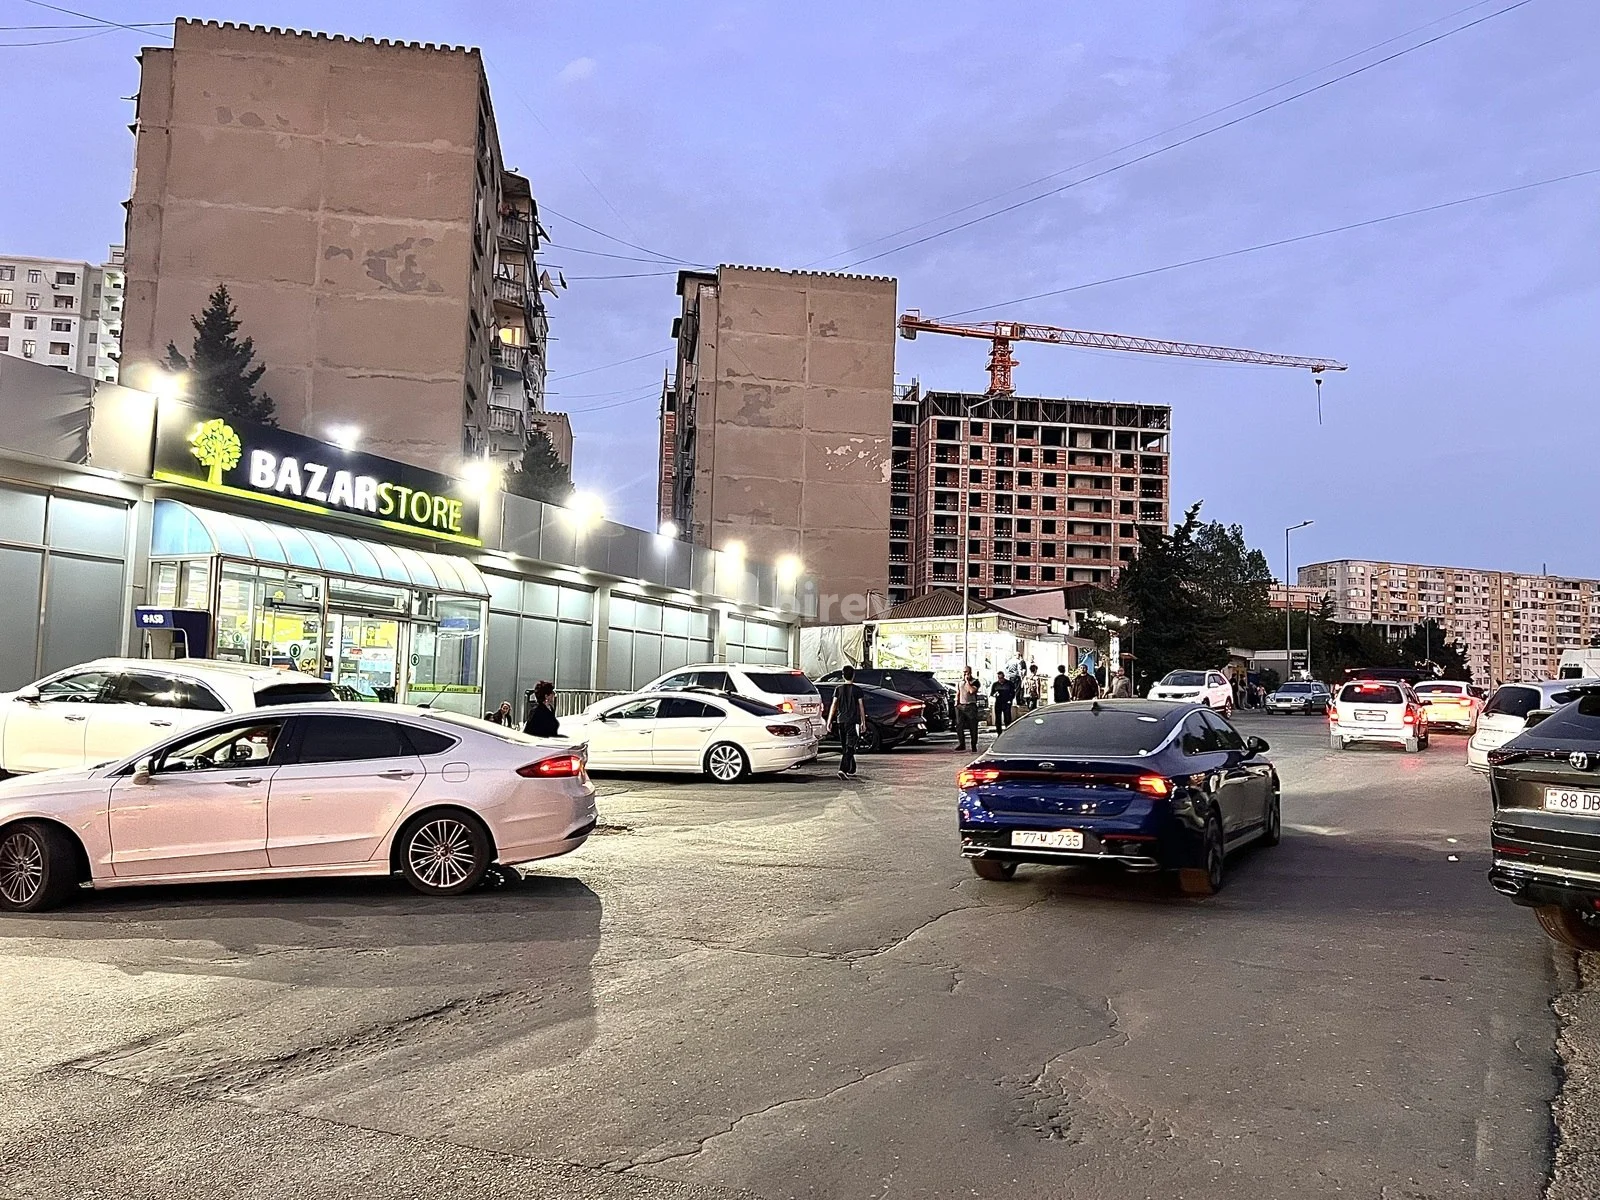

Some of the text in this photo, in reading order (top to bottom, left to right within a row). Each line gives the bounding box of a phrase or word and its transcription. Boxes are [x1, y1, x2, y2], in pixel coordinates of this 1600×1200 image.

[249, 448, 463, 532] BAZARSTORE
[1560, 792, 1600, 810] 88 DB
